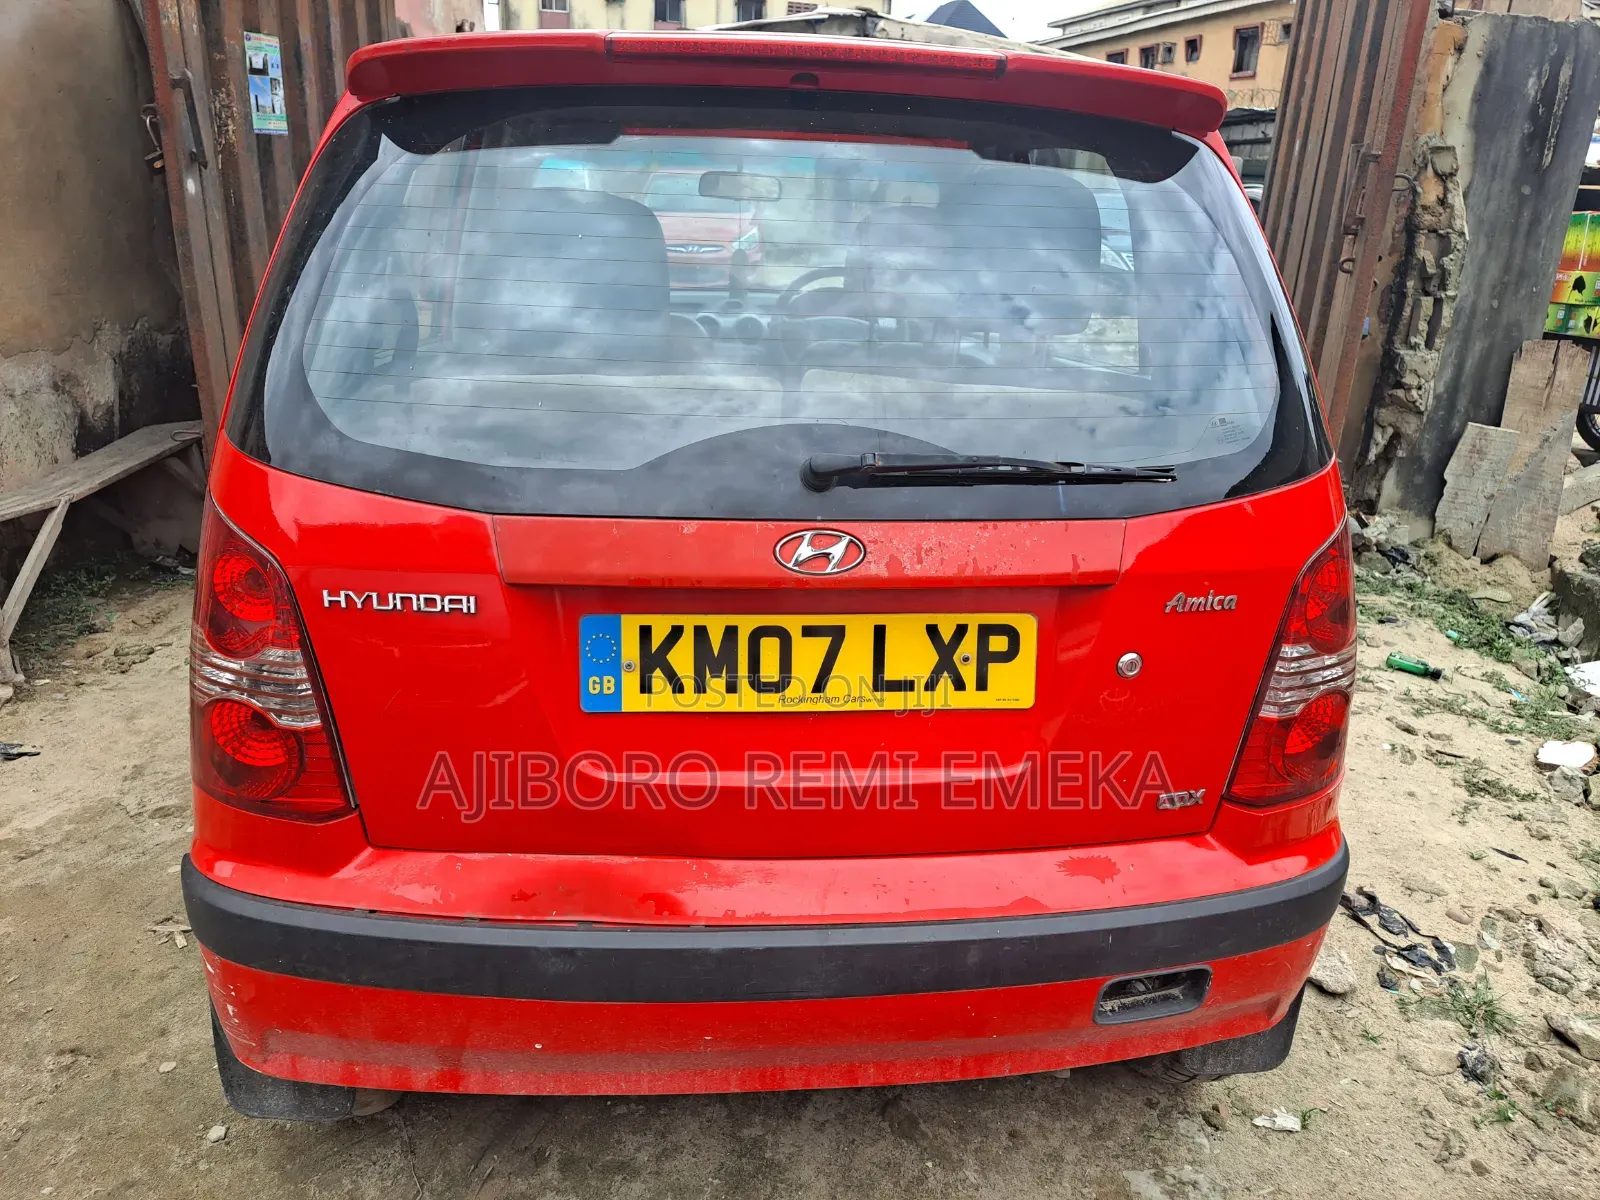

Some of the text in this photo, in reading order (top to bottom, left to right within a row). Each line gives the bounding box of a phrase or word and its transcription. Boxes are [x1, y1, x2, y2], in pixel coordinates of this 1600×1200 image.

[322, 589, 477, 614] HYUNDAI
[1164, 589, 1238, 614] Amica
[638, 623, 1021, 694] KM07 LXP
[588, 675, 615, 695] GB
[777, 694, 840, 706] Rockingham
[843, 694, 866, 704] Cars
